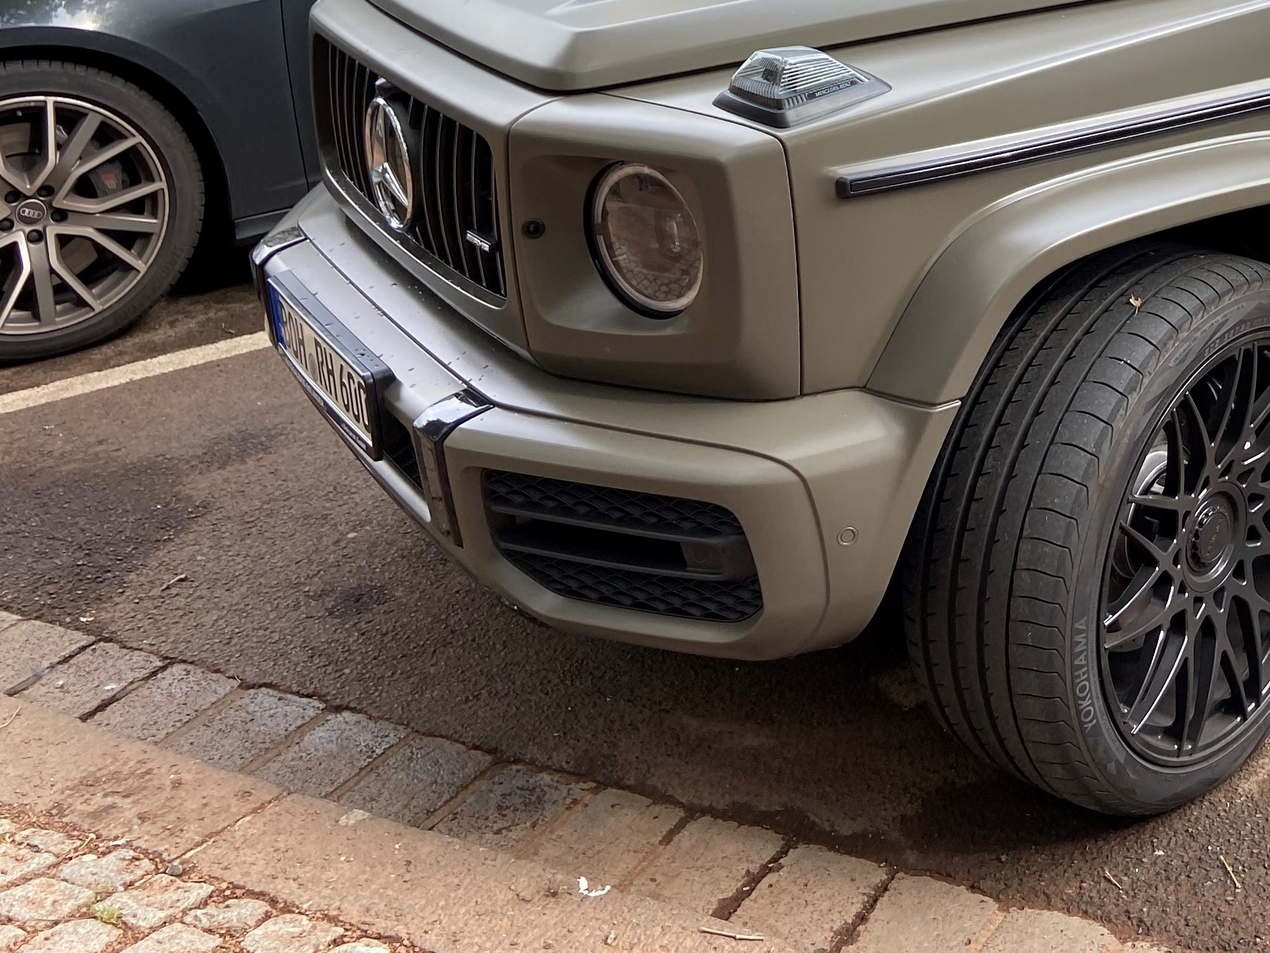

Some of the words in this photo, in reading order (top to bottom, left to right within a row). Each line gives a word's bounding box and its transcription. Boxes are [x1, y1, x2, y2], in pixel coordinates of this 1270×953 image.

[314, 337, 339, 403] RH
[340, 362, 371, 434] 600
[1074, 616, 1097, 734] YOKOHAMA
